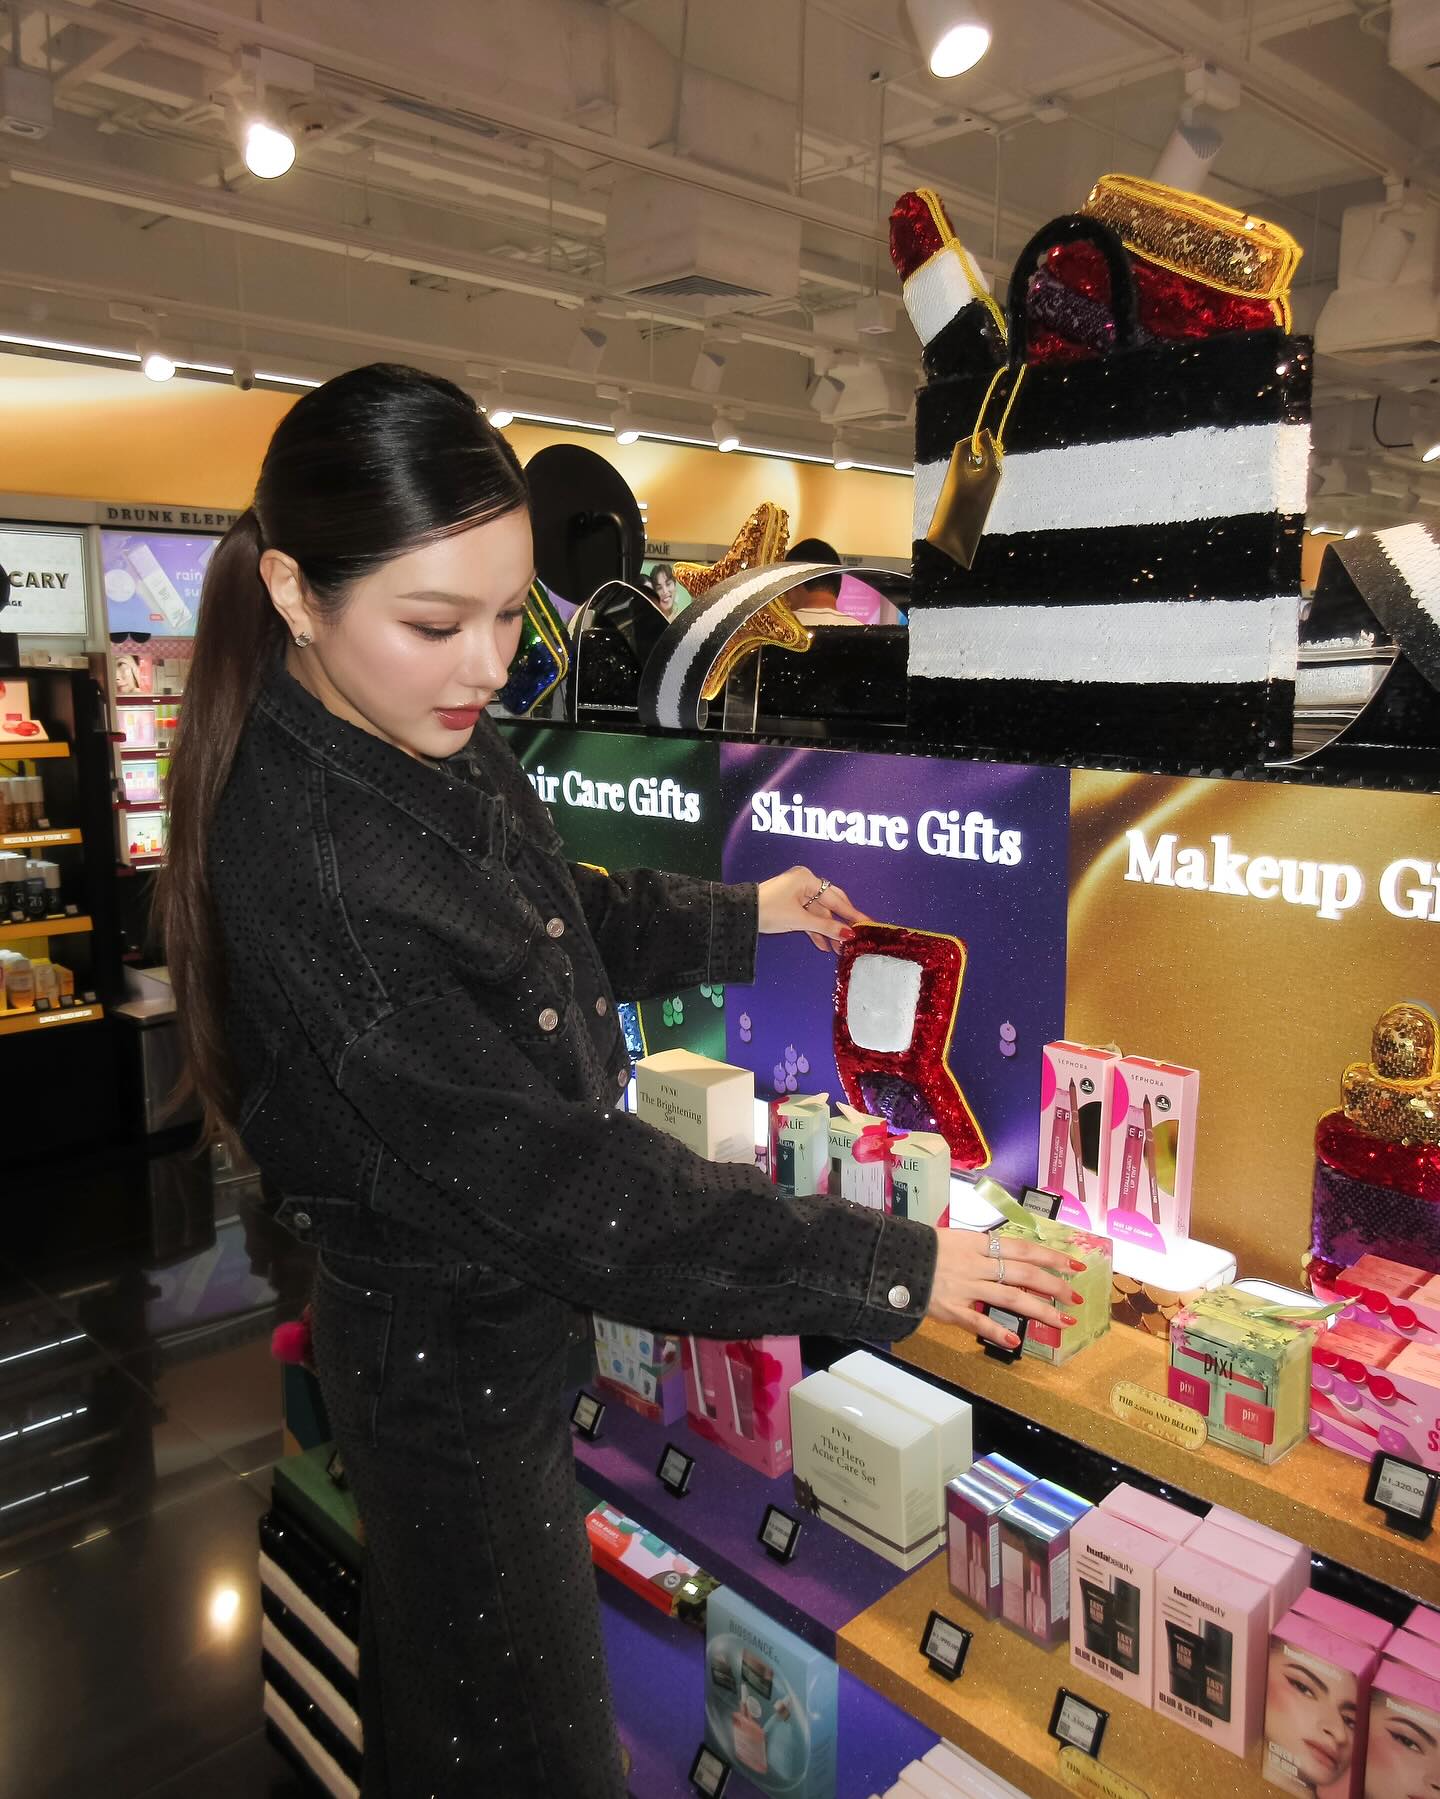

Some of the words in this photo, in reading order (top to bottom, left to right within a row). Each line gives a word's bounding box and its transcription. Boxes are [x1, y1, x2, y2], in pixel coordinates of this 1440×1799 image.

[107, 507, 173, 523] DRUNK
[9, 570, 69, 589] CARY
[562, 770, 625, 813] Care
[628, 777, 701, 823] Gifts
[751, 790, 909, 851] Skincare
[917, 810, 1022, 866] Gifts
[1124, 829, 1364, 921] Makeup
[1057, 1058, 1088, 1070] SEPHORA
[1130, 1074, 1164, 1087] SEPHORA
[639, 1091, 655, 1105] The
[656, 1096, 702, 1125] Brightening
[664, 1111, 676, 1125] Set
[1203, 1351, 1234, 1387] pixi
[1180, 1380, 1196, 1395] pixi
[1155, 1411, 1170, 1424] AND
[1171, 1418, 1199, 1436] BELOW
[1242, 1407, 1260, 1424] pixi
[820, 1435, 840, 1454] The
[840, 1447, 866, 1468] Hero
[812, 1443, 835, 1463] Acne
[836, 1456, 860, 1477] Care
[861, 1470, 876, 1486] Set
[1098, 1659, 1109, 1672] SET
[1159, 1691, 1176, 1708] BLUR
[1184, 1706, 1197, 1719] SET
